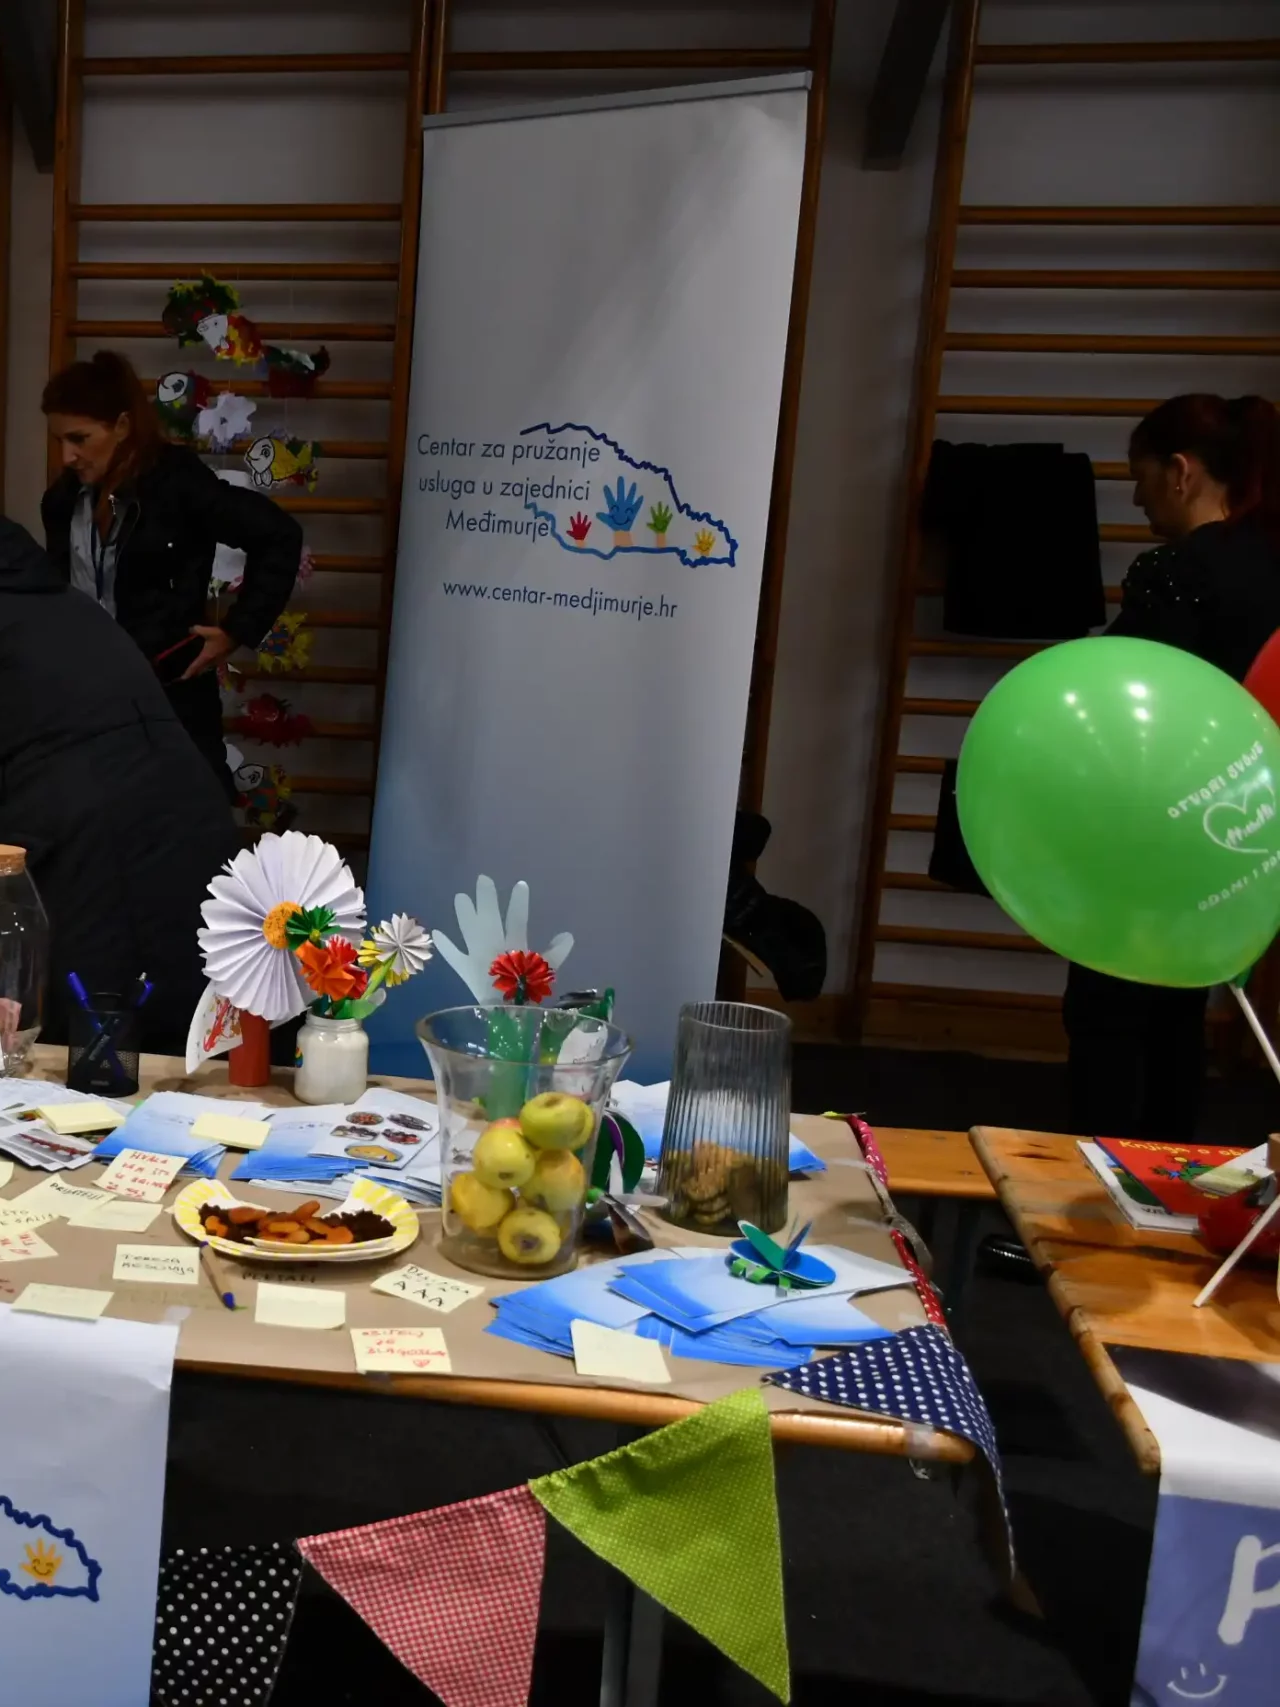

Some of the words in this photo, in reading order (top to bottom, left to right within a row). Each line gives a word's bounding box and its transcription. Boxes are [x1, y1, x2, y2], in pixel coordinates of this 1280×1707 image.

[417, 433, 476, 458] Centar
[481, 442, 505, 459] za
[511, 438, 601, 468] pružanje
[419, 470, 475, 500] usluga
[482, 480, 494, 497] u
[500, 476, 591, 503] zajednici
[445, 510, 550, 543] Međimurje
[443, 581, 677, 621] www.centar-medjimurje.hr
[1119, 1140, 1191, 1154] Knjiga
